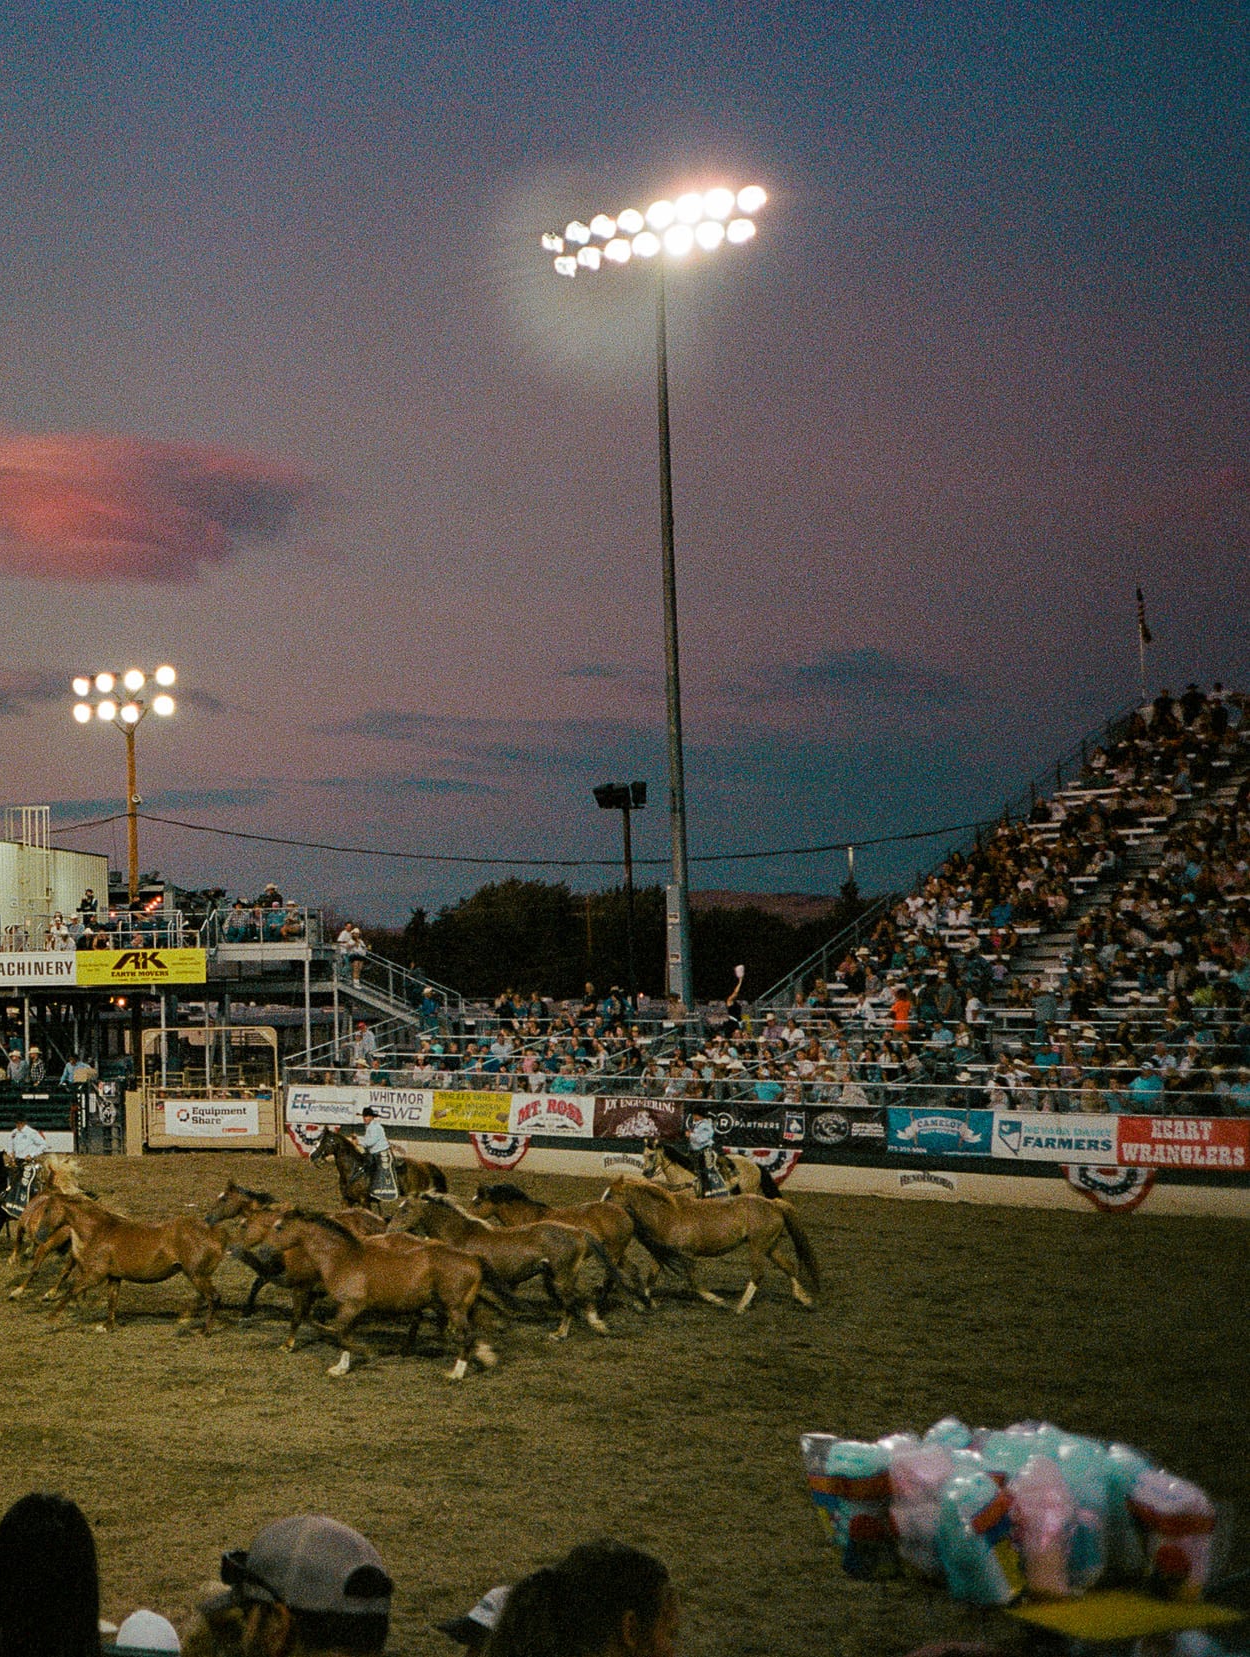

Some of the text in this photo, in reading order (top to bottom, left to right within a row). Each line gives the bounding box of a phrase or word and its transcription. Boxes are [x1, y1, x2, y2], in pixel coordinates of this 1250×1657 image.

[112, 951, 168, 970] AK
[370, 1090, 424, 1105] WHITMOR
[191, 1106, 247, 1116] Equipment
[517, 1099, 542, 1126] MT.
[546, 1098, 585, 1128] ROSE
[619, 1098, 675, 1114] ENGINEERING
[191, 1115, 222, 1125] Share
[734, 1119, 780, 1130] PARTNERS
[1024, 1125, 1071, 1136] NEVADA
[1152, 1119, 1212, 1141] HEART
[1022, 1136, 1113, 1151] FARMERS
[1121, 1142, 1246, 1166] WRANGLERS
